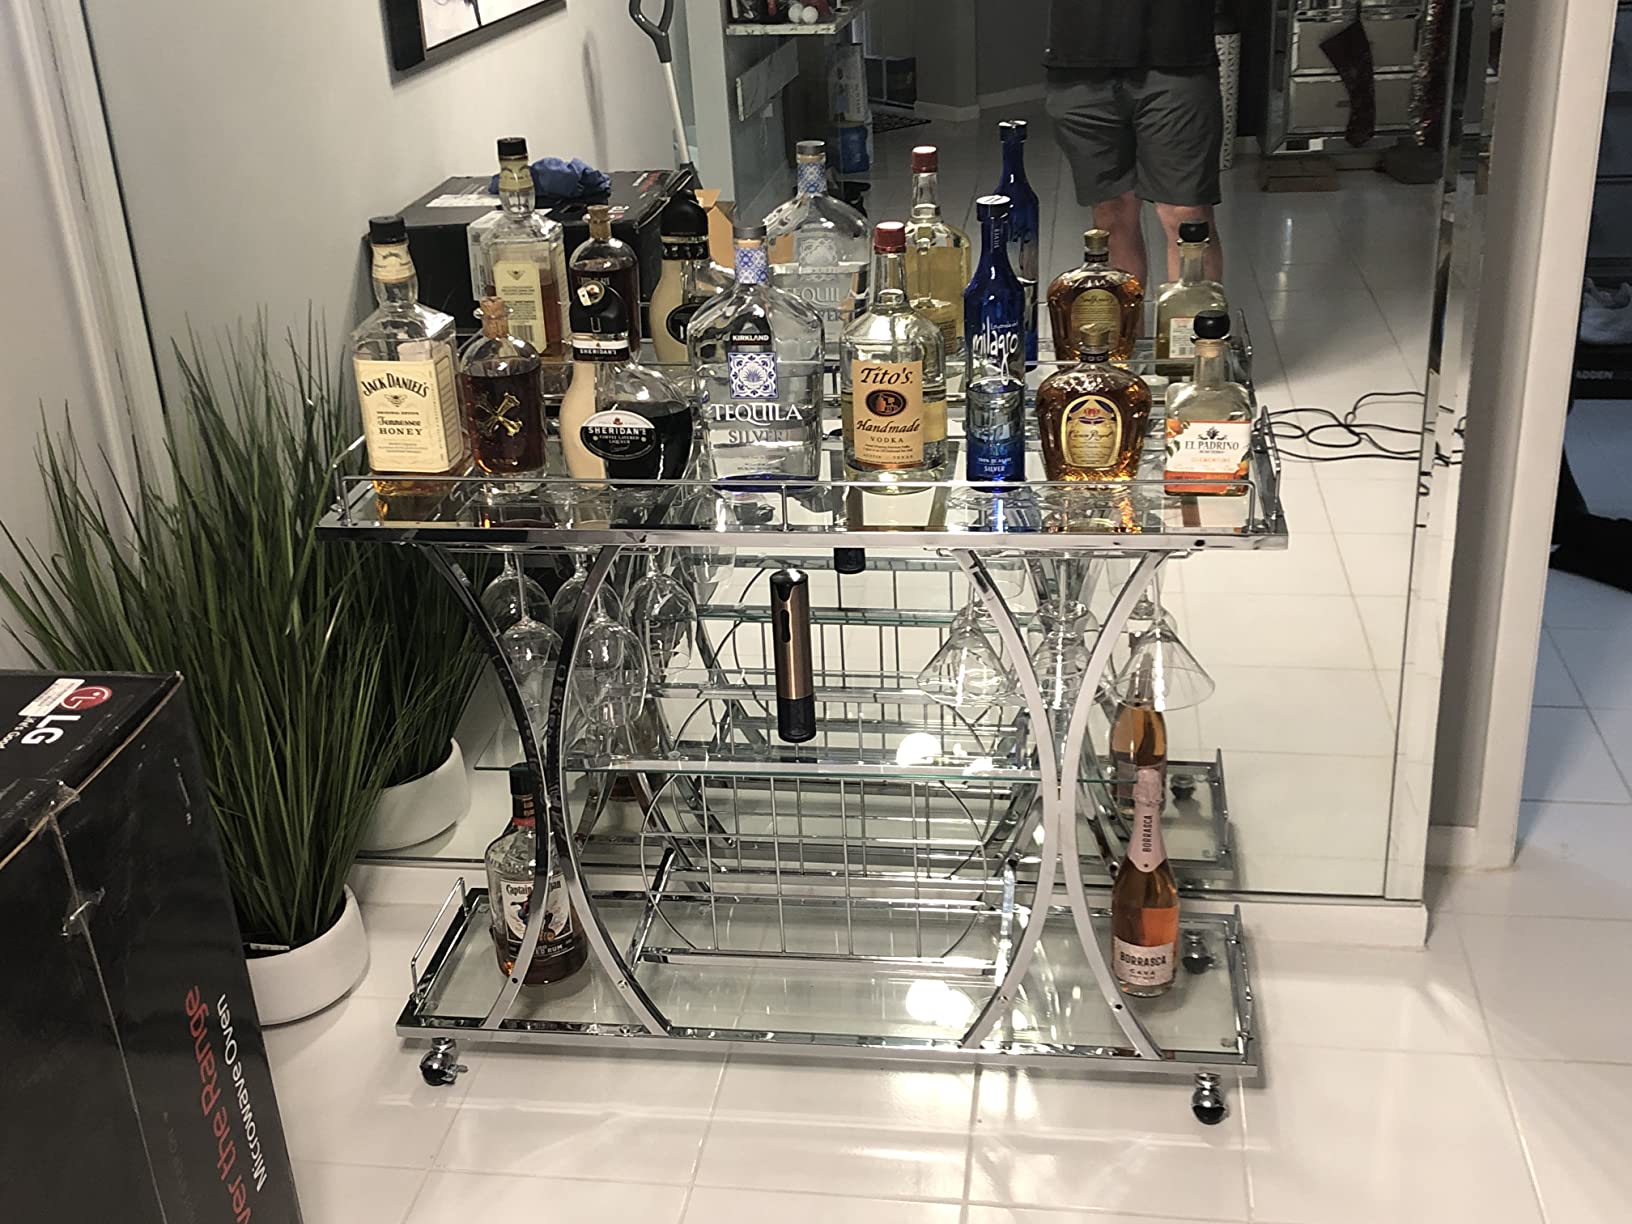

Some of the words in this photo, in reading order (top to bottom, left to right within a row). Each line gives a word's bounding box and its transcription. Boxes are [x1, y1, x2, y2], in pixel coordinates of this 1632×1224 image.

[732, 334, 770, 342] KIRKLAND
[972, 316, 1019, 386] milagro
[361, 377, 388, 397] JACK
[385, 372, 430, 398] DANIEL'S
[710, 402, 804, 426] TEQUILA
[856, 418, 920, 434] Handmade
[378, 427, 423, 435] HONEY
[588, 427, 647, 436] SHERIDAN'S
[728, 430, 784, 444] SILVER
[1185, 440, 1195, 449] EL
[1198, 440, 1240, 450] PADRINO
[20, 714, 82, 745] LG
[1142, 815, 1153, 853] BORRASCA
[506, 884, 534, 896] Captain
[1120, 951, 1167, 967] BORRASCA
[216, 993, 238, 1066] Oven
[185, 985, 222, 1117] Range
[232, 1061, 268, 1192] Microwave
[212, 1106, 237, 1181] the
[228, 1174, 252, 1224] ver
